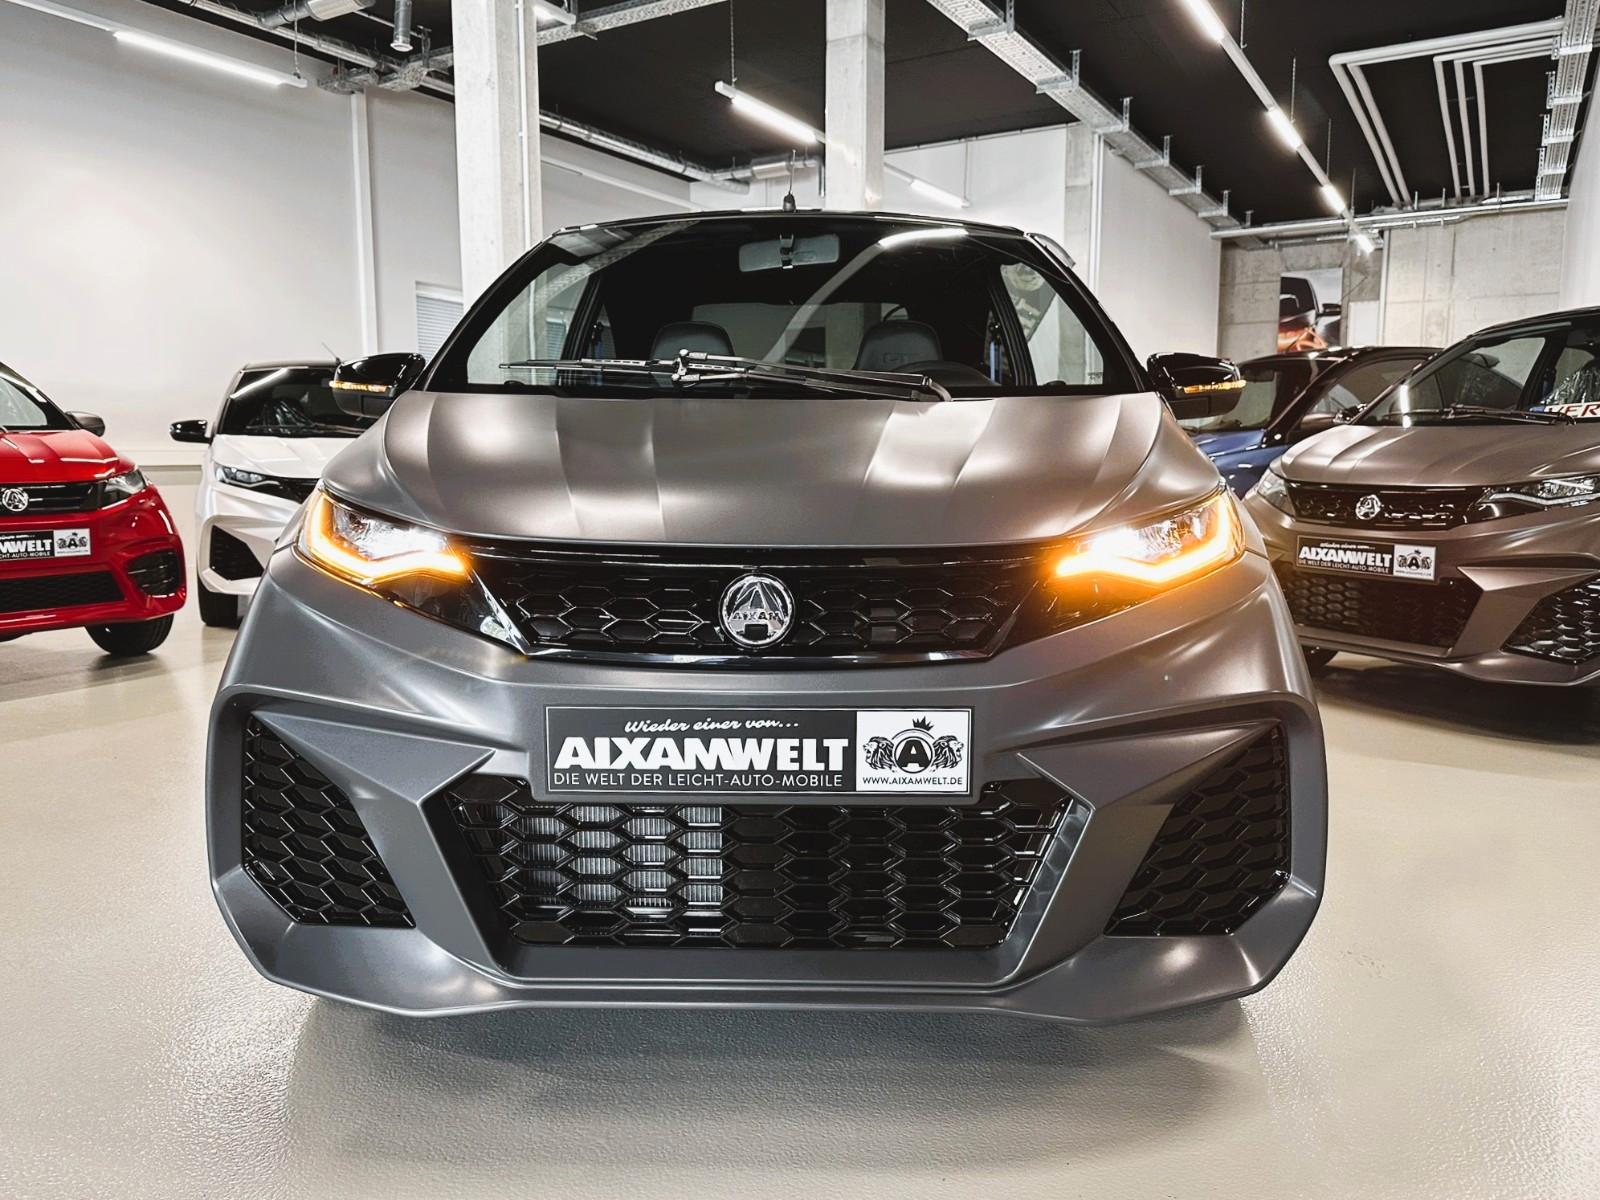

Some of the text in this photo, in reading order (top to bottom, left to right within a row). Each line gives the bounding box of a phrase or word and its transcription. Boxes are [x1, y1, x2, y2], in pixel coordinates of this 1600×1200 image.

[1299, 546, 1392, 568] AIXAMWELT
[624, 718, 690, 733] Wieder
[693, 717, 741, 730] einer
[554, 737, 849, 771] AIXAMWELT
[554, 772, 842, 787] DIE WELT DER LEICHT-AUTO-MOBILE
[862, 777, 963, 785] WWW.AIXAMWELT.DE
